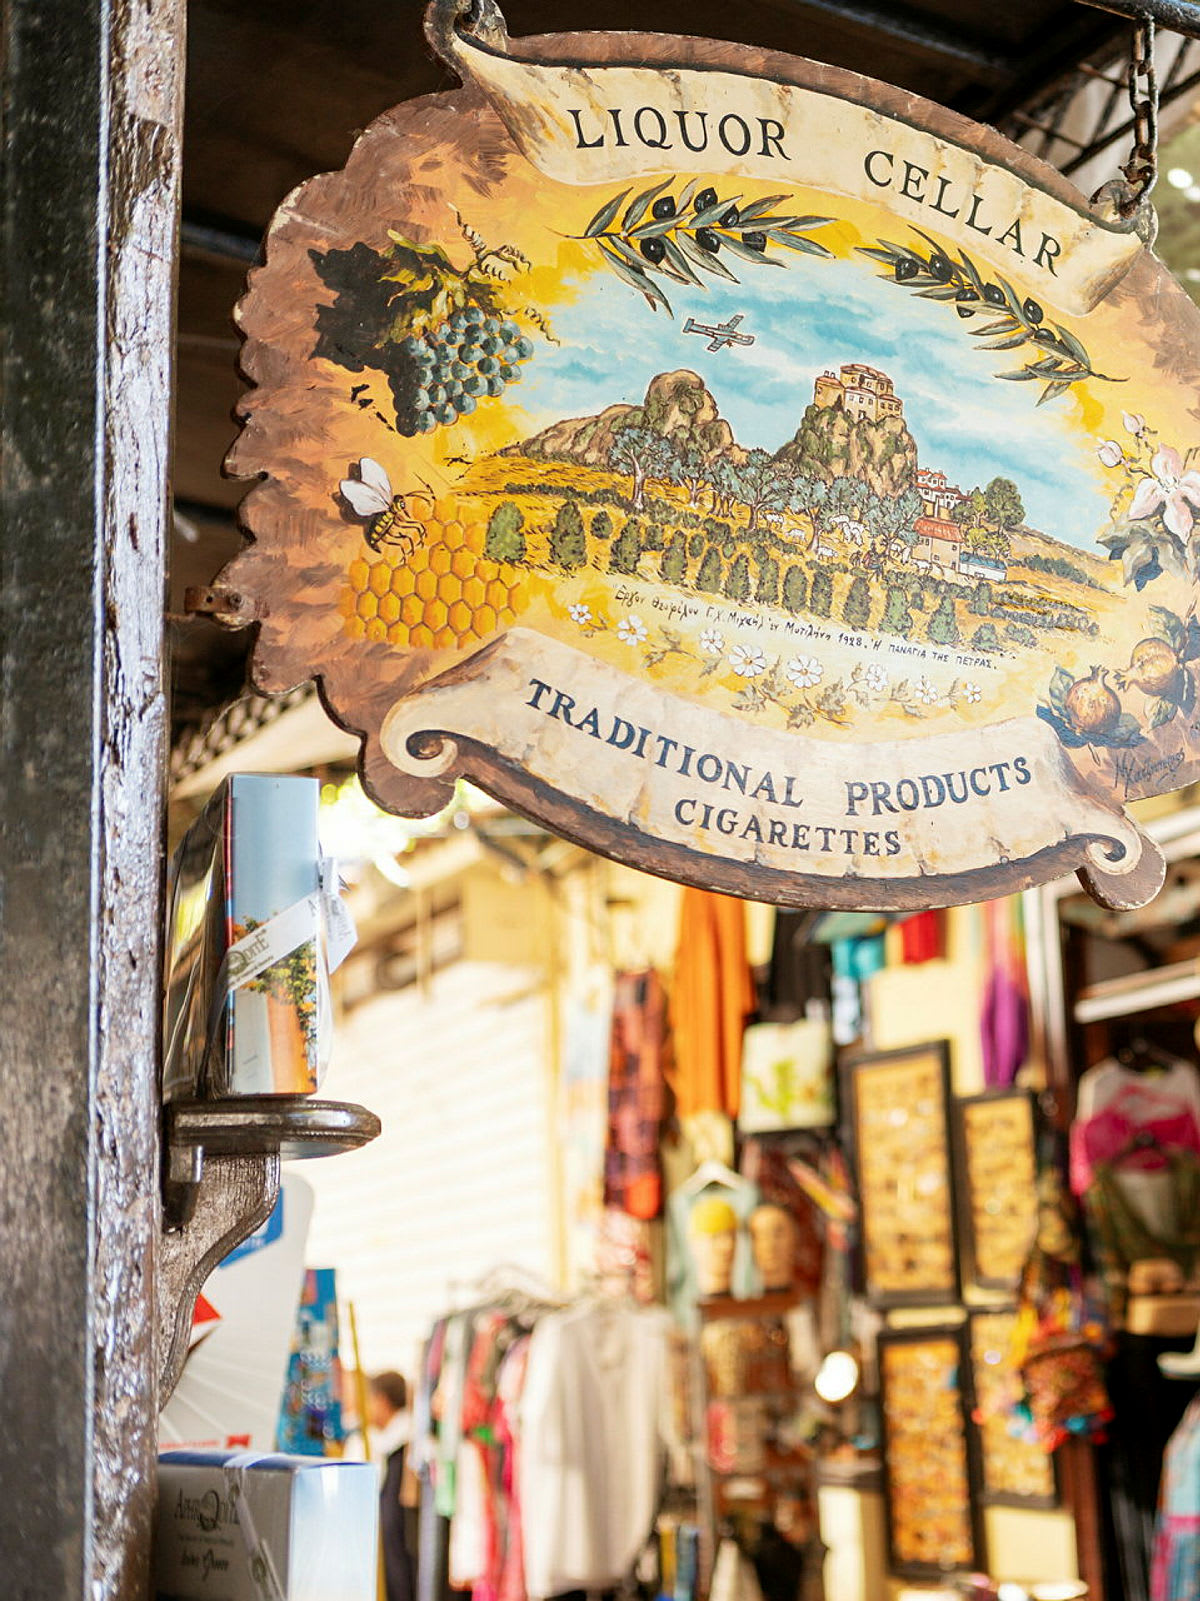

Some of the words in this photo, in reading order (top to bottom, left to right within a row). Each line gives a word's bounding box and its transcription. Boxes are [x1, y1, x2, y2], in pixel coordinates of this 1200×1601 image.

[567, 106, 792, 161] LIQUOR
[863, 149, 1065, 278] CELLAR
[932, 651, 949, 663] ΤΗΣ
[525, 678, 803, 807] TRADITIONAL
[845, 756, 1032, 816] PRODUCTS
[675, 799, 901, 857] CIGARETTES
